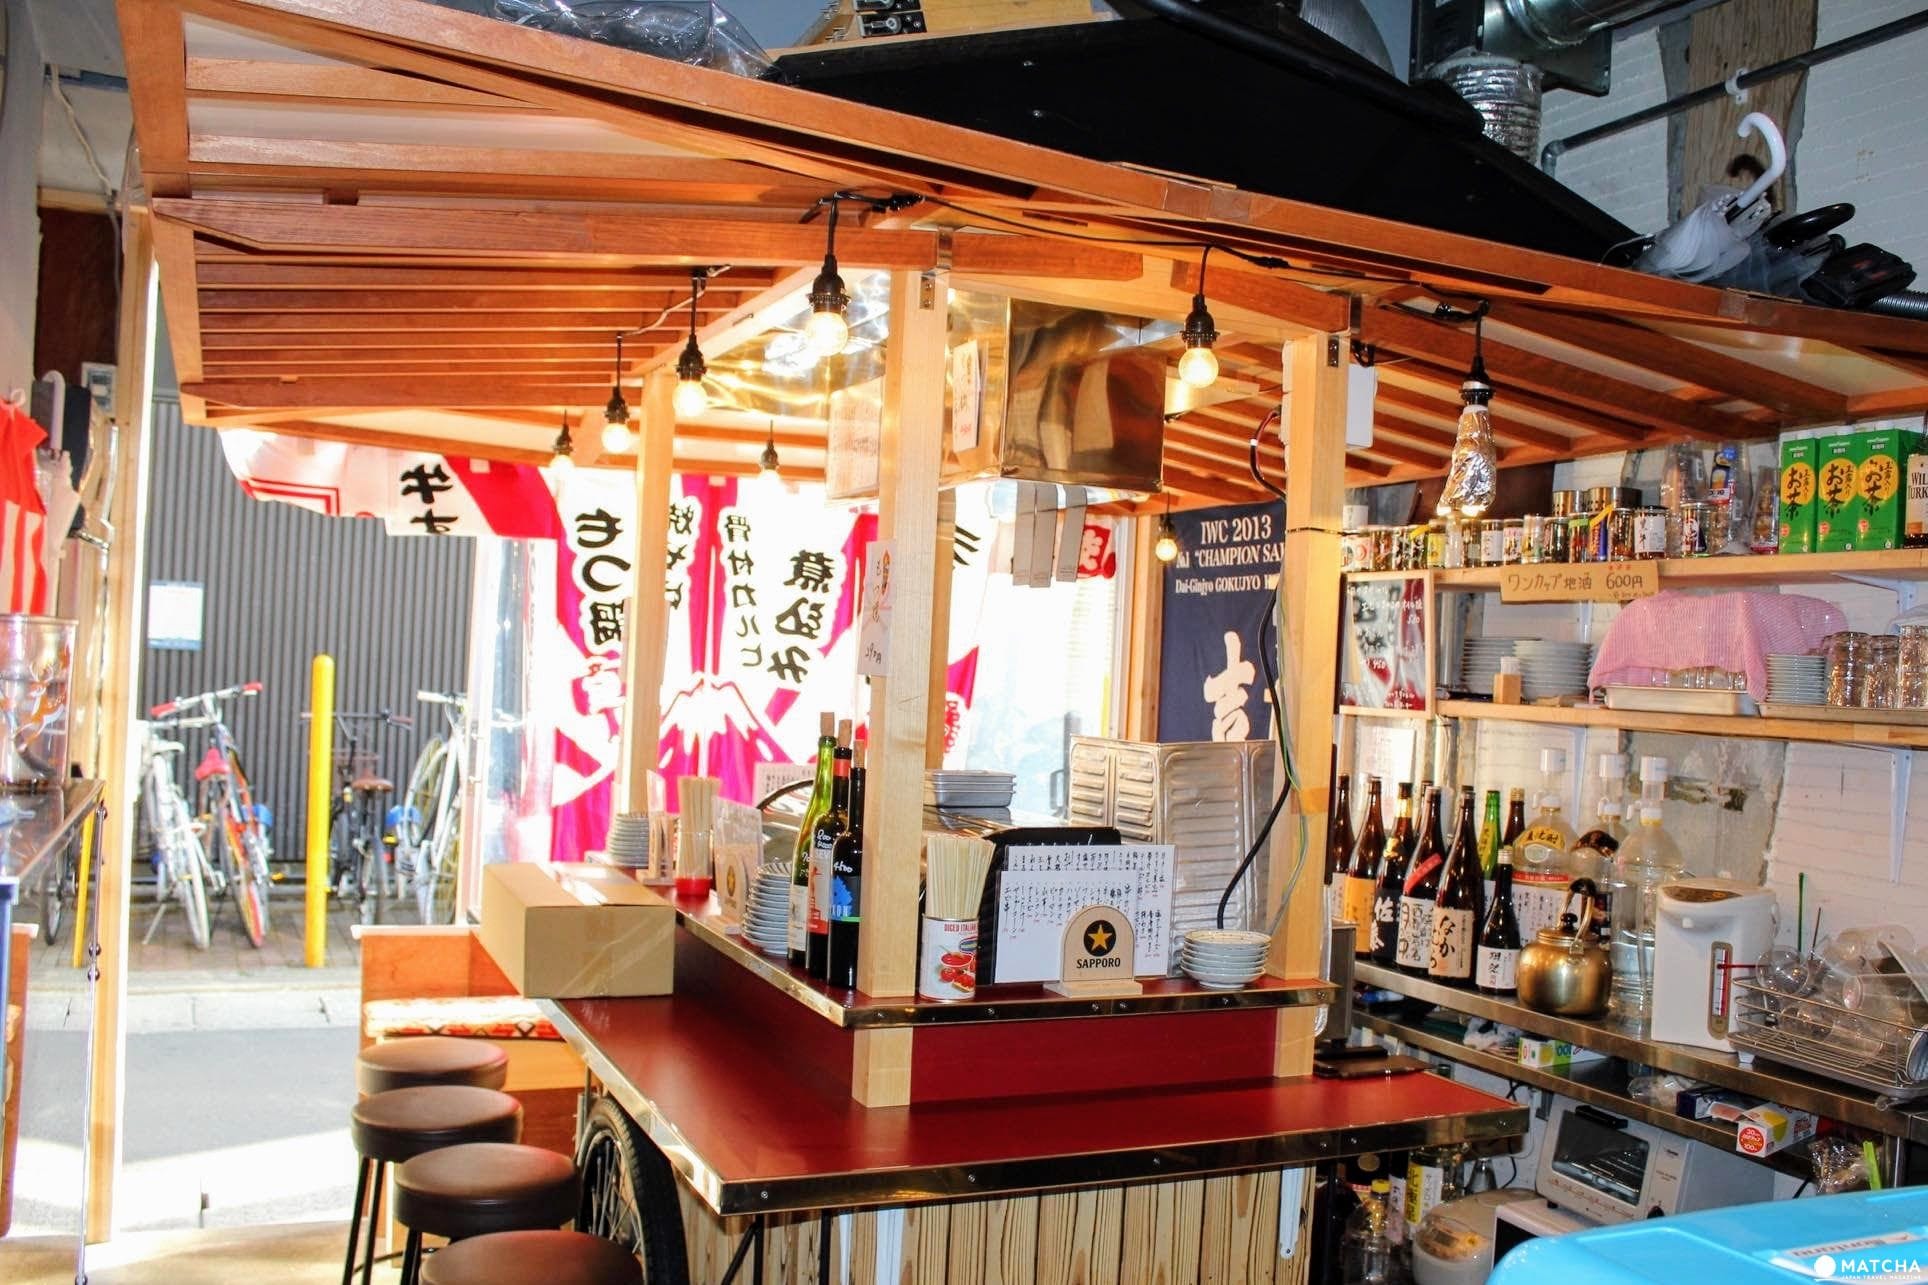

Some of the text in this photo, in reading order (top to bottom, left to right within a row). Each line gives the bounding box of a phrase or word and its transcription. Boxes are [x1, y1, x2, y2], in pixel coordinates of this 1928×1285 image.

[1200, 514, 1272, 545] IWC 2013
[1215, 574, 1261, 593] GOKUJYO
[1508, 572, 1643, 592] ワンカップ地酒 600円
[1076, 957, 1121, 969] SAPPORO
